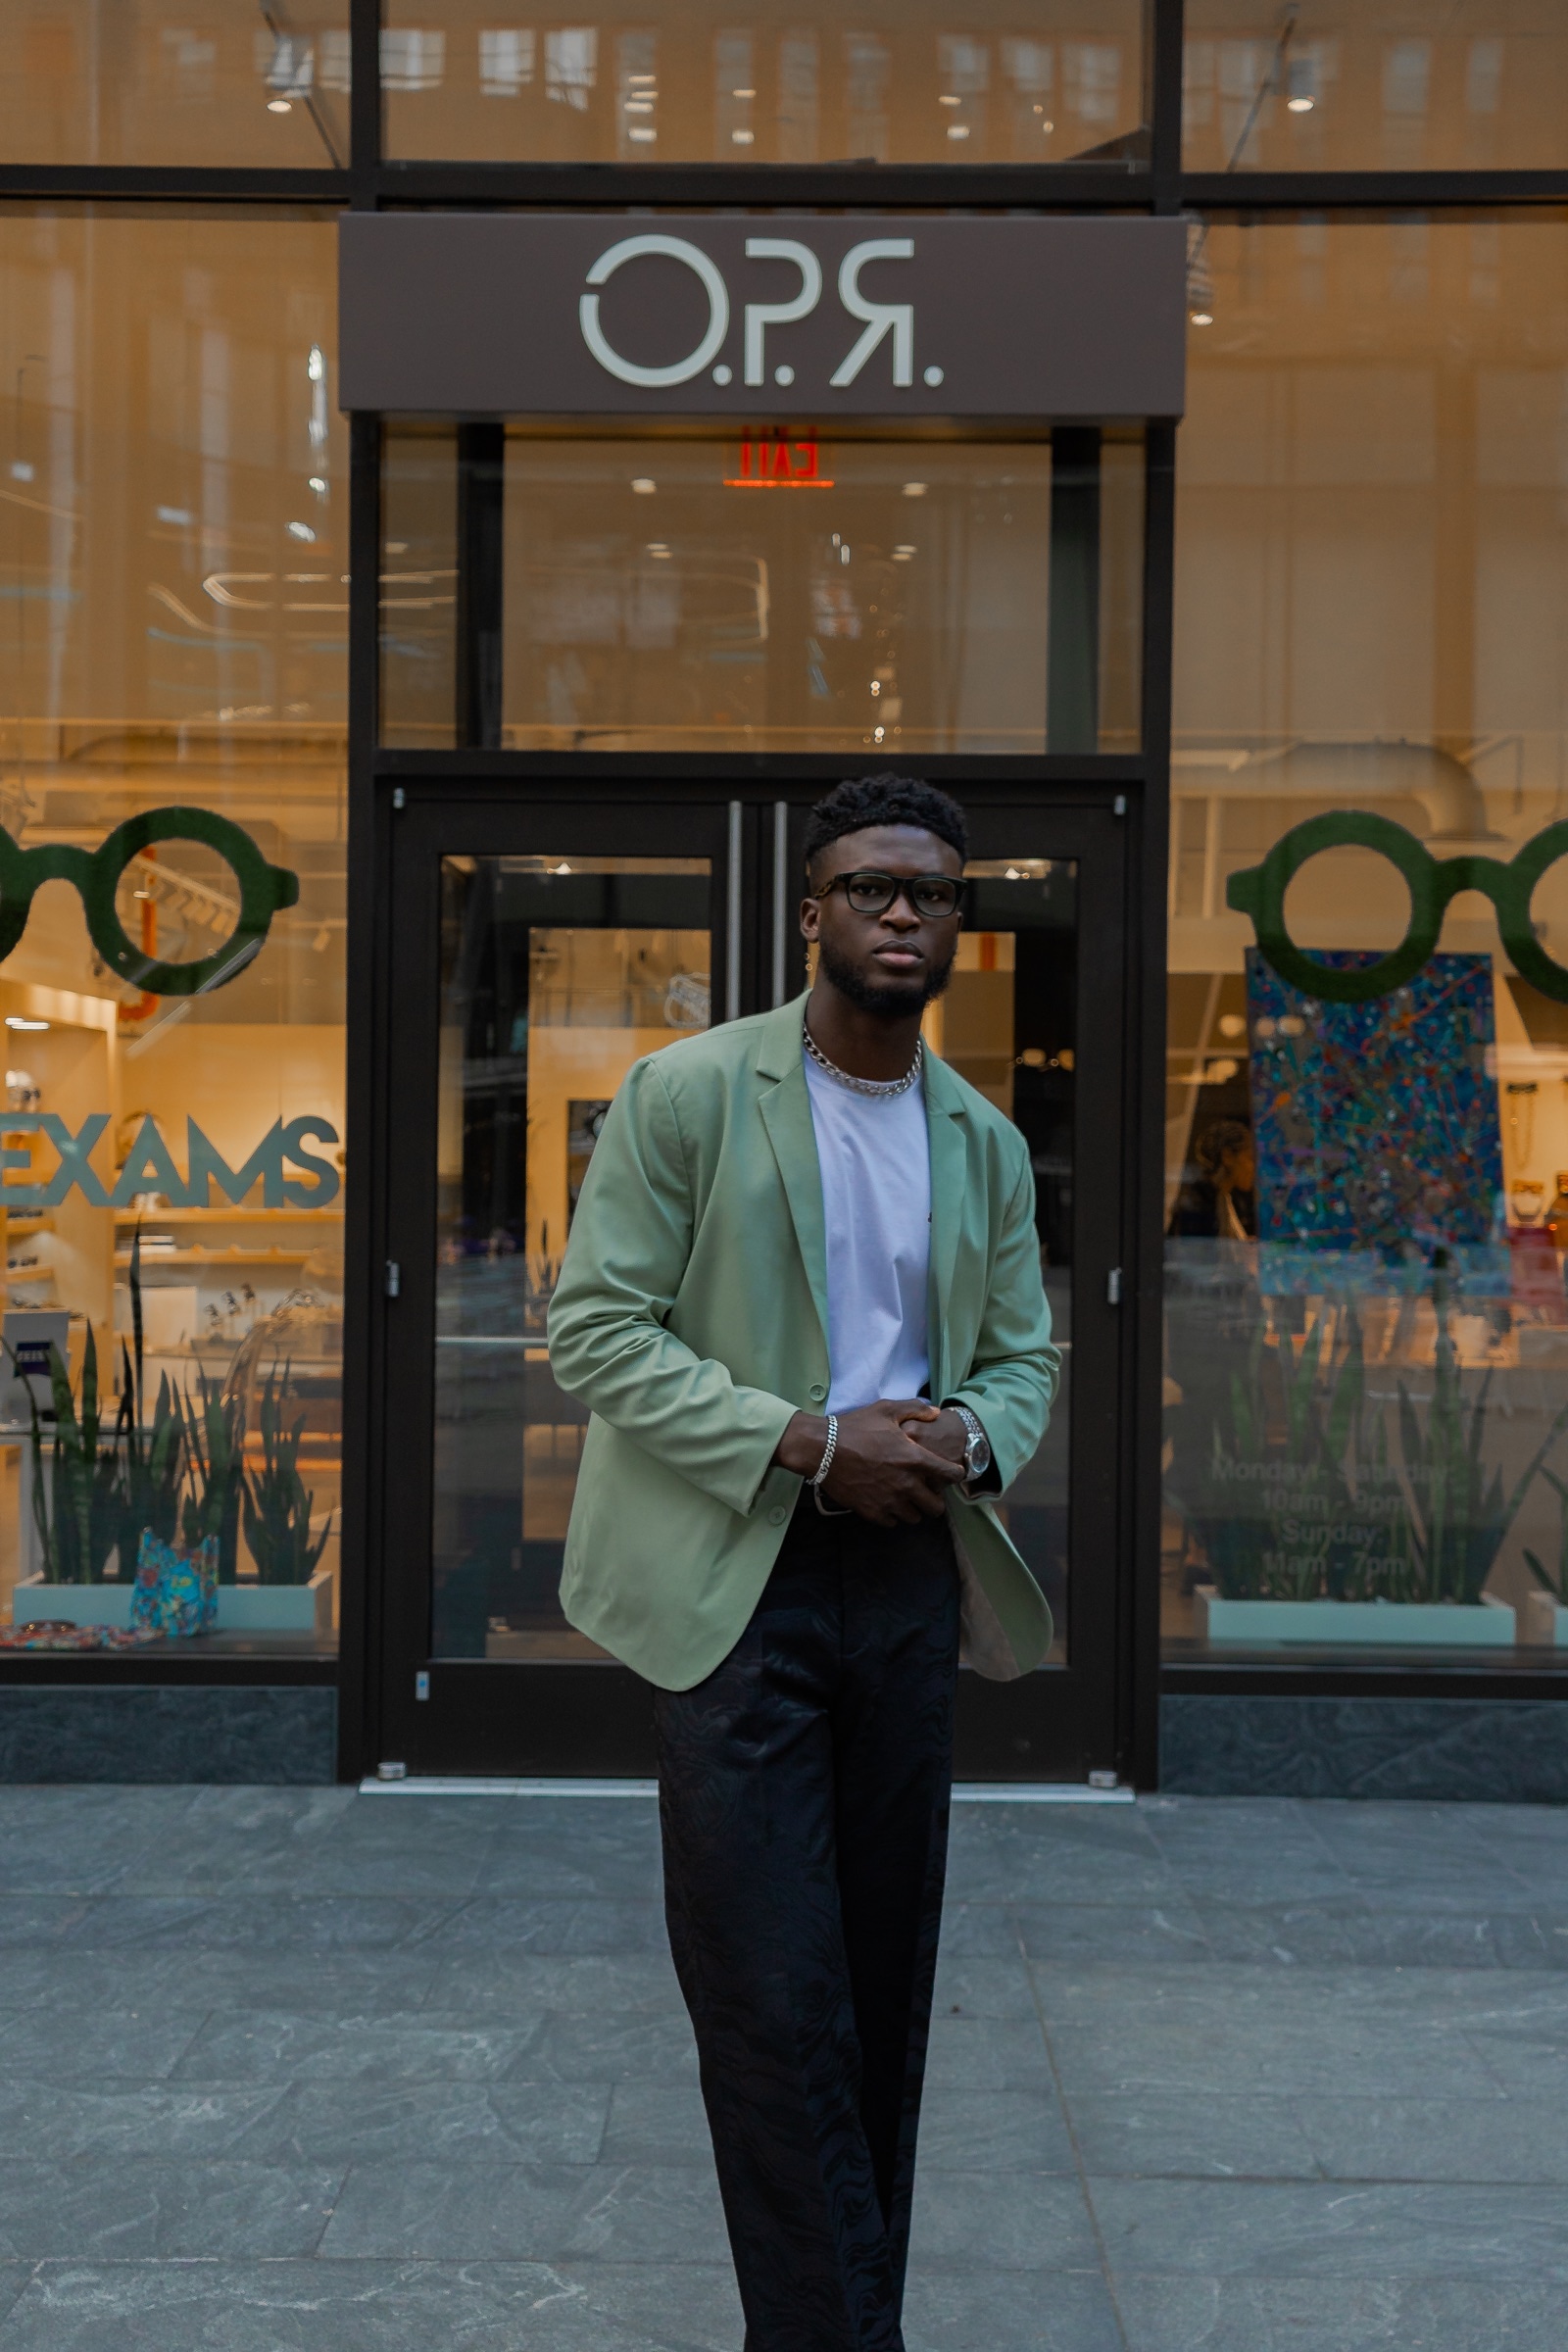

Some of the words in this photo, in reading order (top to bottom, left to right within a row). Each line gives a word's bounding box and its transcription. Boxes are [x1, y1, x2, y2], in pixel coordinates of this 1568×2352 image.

[0, 1113, 340, 1209] EXAMS
[1260, 1490, 1329, 1512] 10am
[1351, 1550, 1406, 1582] 7pm
